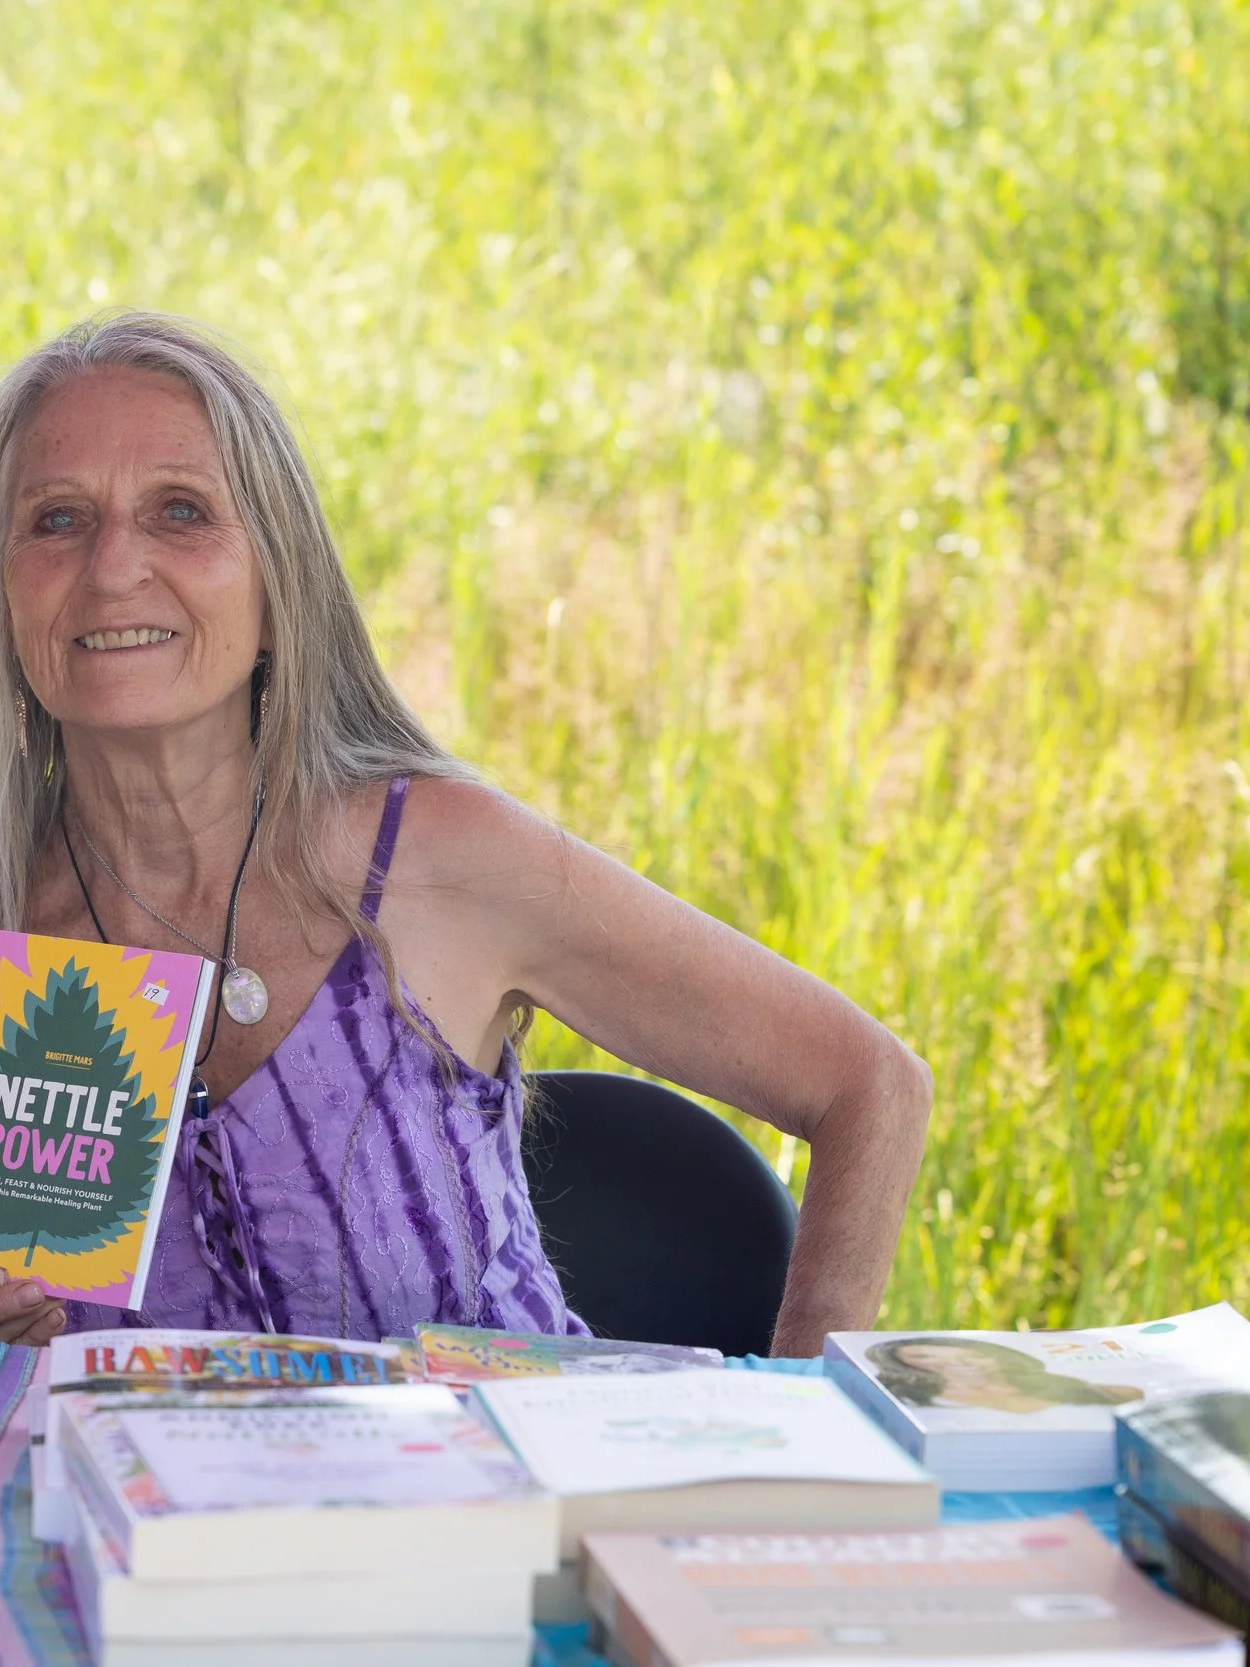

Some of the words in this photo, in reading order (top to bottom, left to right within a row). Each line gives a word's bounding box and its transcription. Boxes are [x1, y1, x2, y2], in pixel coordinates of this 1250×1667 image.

[144, 987, 160, 1000] 19
[45, 1051, 74, 1064] BRIGITTE
[73, 1055, 94, 1066] MARS
[4, 1178, 29, 1189] FEAST
[29, 1182, 36, 1190] &
[36, 1184, 73, 1196] NOURISH
[74, 1189, 114, 1202] YOURSELF
[10, 1190, 53, 1204] Remarkable
[53, 1197, 82, 1210] Healing
[82, 1203, 103, 1212] Plant
